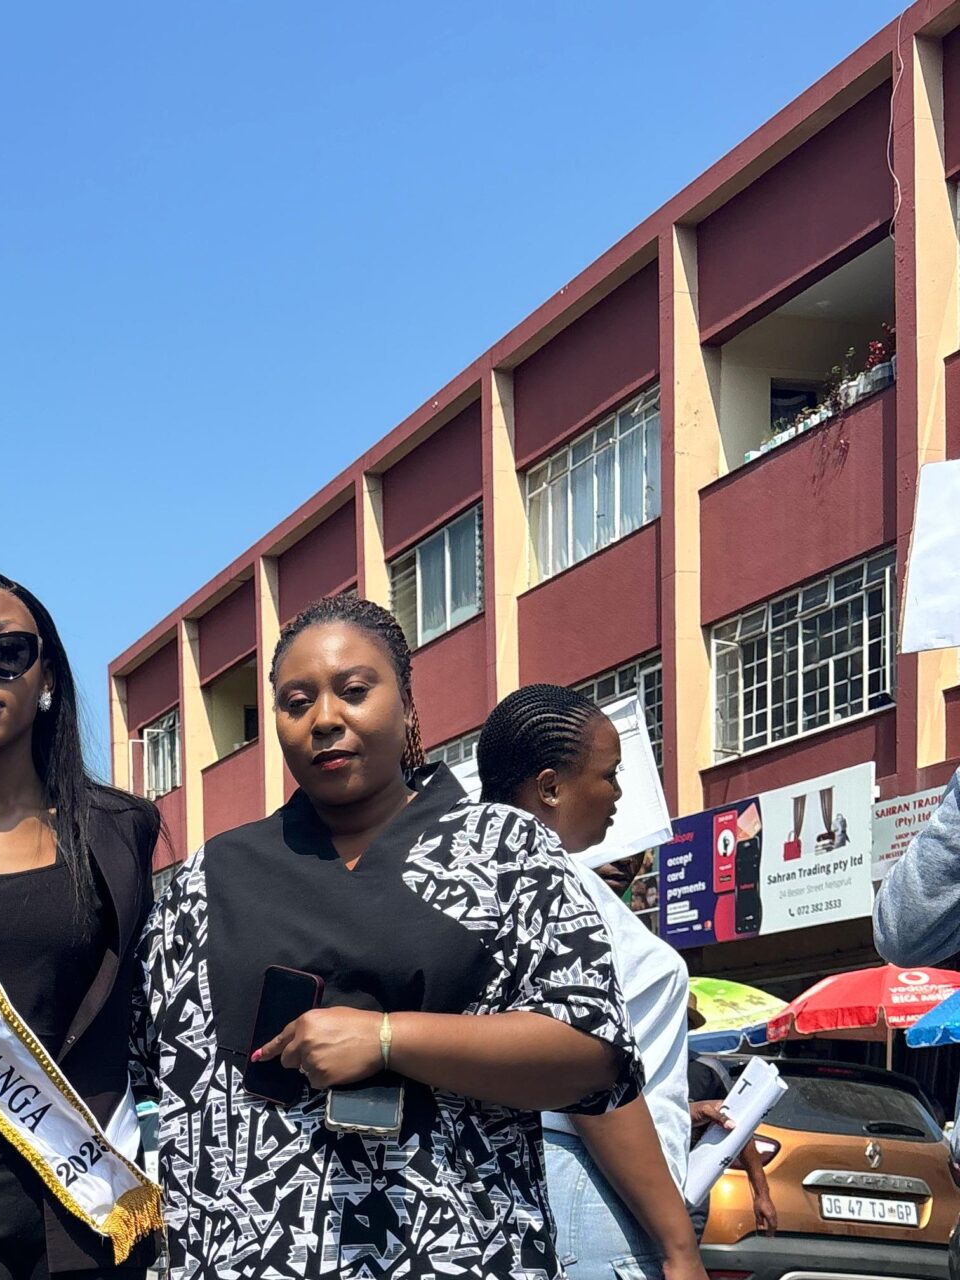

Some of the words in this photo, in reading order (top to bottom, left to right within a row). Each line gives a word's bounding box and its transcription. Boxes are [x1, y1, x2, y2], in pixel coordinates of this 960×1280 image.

[875, 802, 910, 819] SAHRAN
[667, 852, 693, 867] accept
[667, 867, 686, 882] card
[767, 871, 797, 885] Sahran
[798, 863, 831, 877] Trading
[833, 859, 848, 874] pty
[850, 853, 863, 867] ltd
[667, 881, 706, 901] payments
[825, 1197, 842, 1215] JG
[847, 1200, 863, 1217] 47
[869, 1202, 886, 1219] TJ
[896, 1204, 912, 1222] GP
